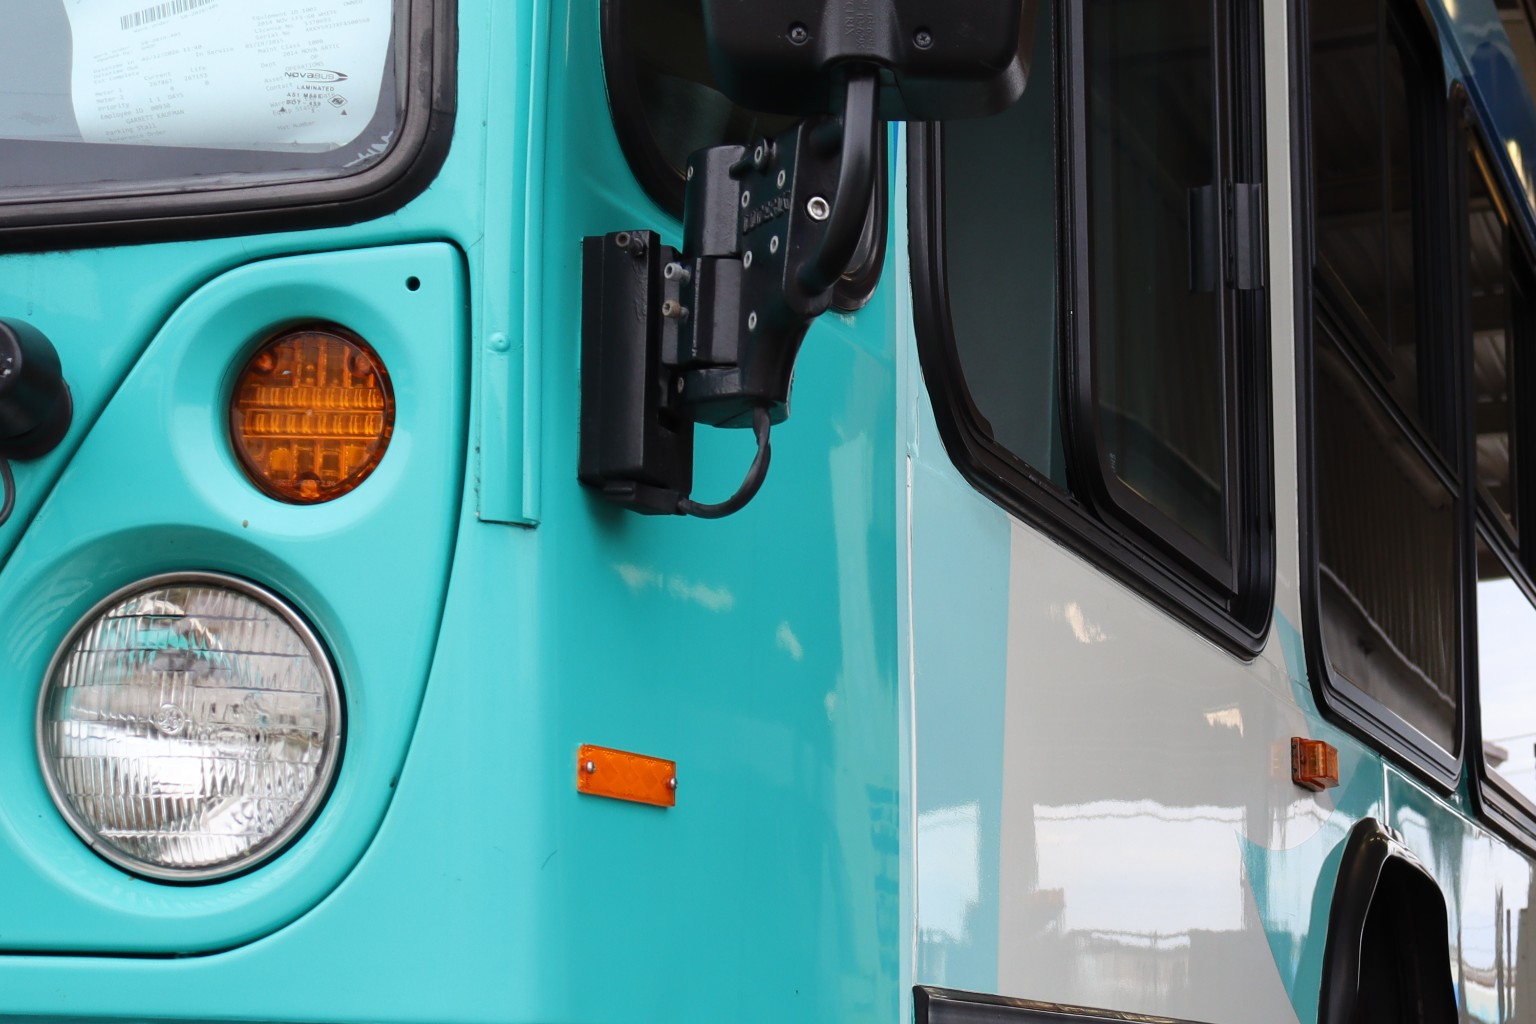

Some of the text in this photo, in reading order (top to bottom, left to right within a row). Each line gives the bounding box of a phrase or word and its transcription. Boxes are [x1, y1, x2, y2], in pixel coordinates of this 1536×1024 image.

[252, 11, 287, 21] Equipment
[254, 25, 282, 33] License
[255, 32, 278, 40] Serial
[285, 61, 324, 72] OPERATIONS
[143, 72, 172, 81] Current
[97, 102, 130, 112] Priority
[100, 111, 132, 120] Employee
[126, 109, 185, 124] GARRETT KAUFMAN
[105, 122, 157, 136] Parking Stall
